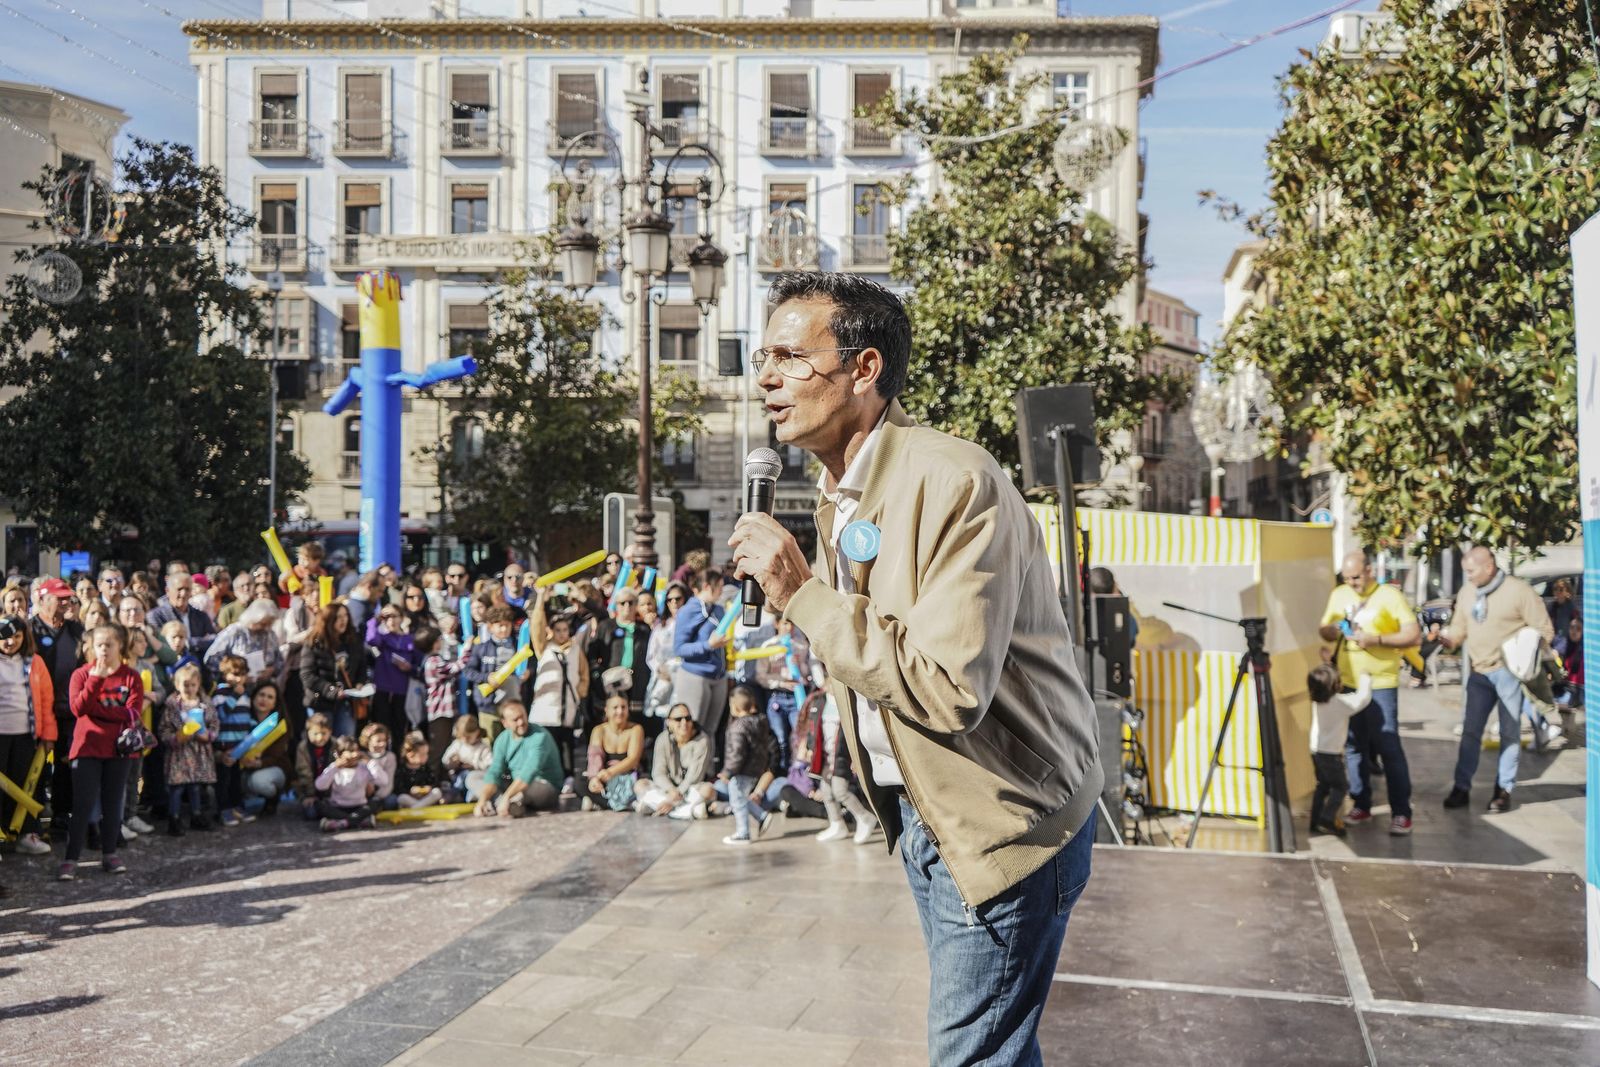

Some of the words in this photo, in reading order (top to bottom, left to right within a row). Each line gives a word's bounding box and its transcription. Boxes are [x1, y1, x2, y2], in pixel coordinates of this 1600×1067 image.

[377, 241, 391, 257] EL
[396, 241, 437, 257] RUIDO
[441, 240, 468, 257] NOS
[774, 498, 817, 510] UEVA
